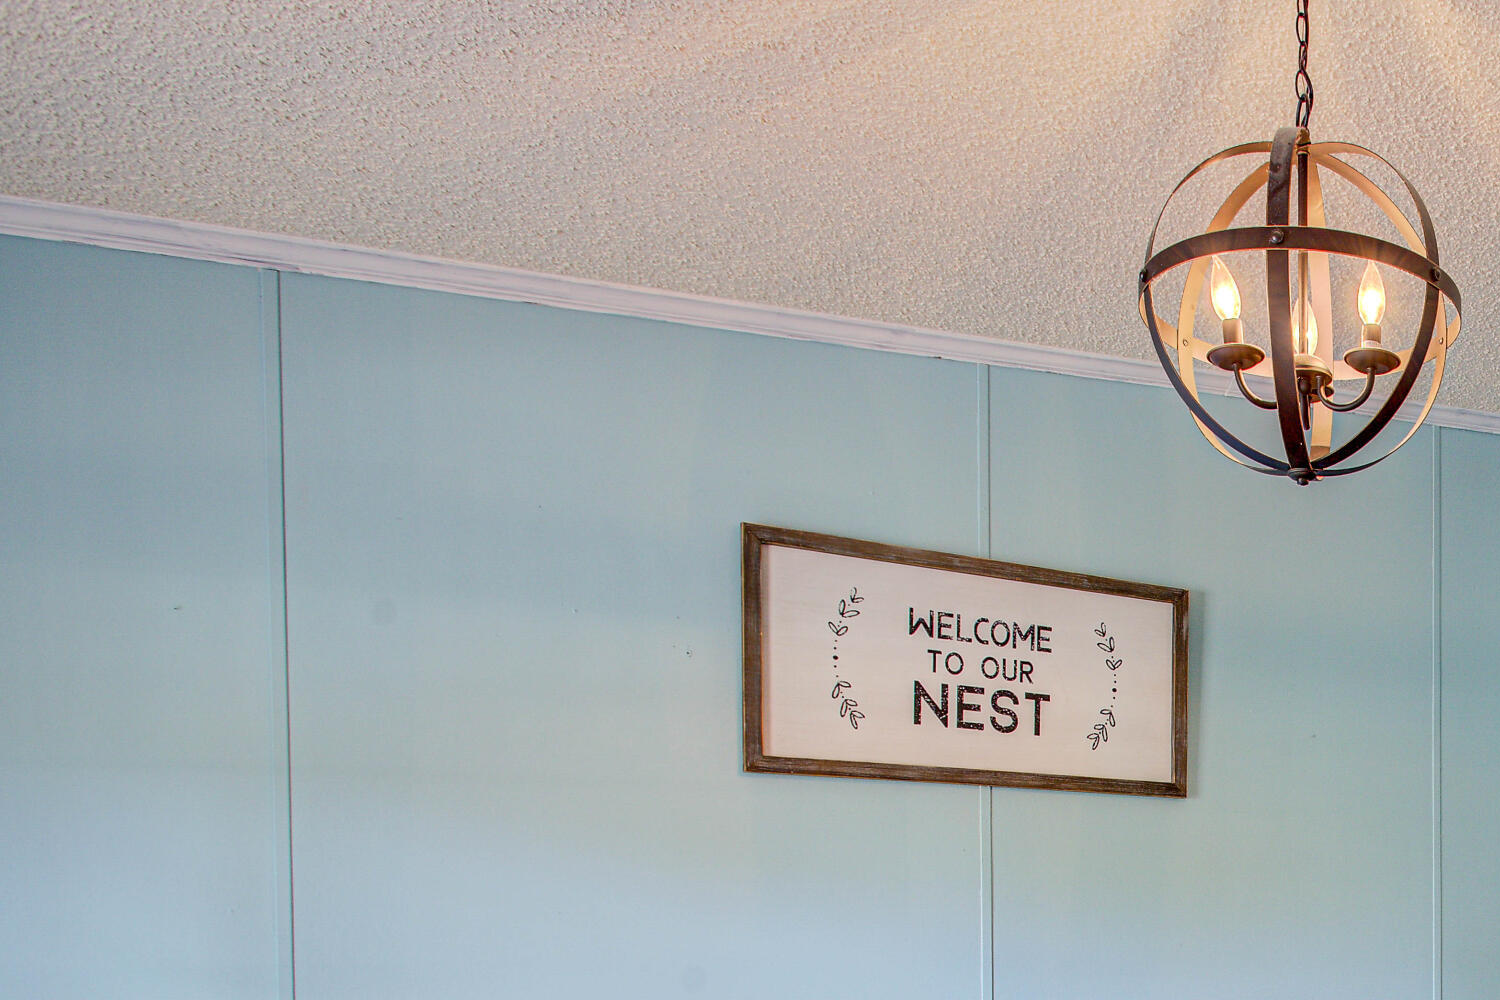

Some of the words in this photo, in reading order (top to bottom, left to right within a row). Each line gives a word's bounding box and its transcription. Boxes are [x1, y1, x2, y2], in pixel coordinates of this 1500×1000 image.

[908, 607, 1053, 654] WELCOME
[927, 649, 965, 675] TO
[980, 656, 1034, 684] OUR
[913, 680, 1051, 737] NEST
